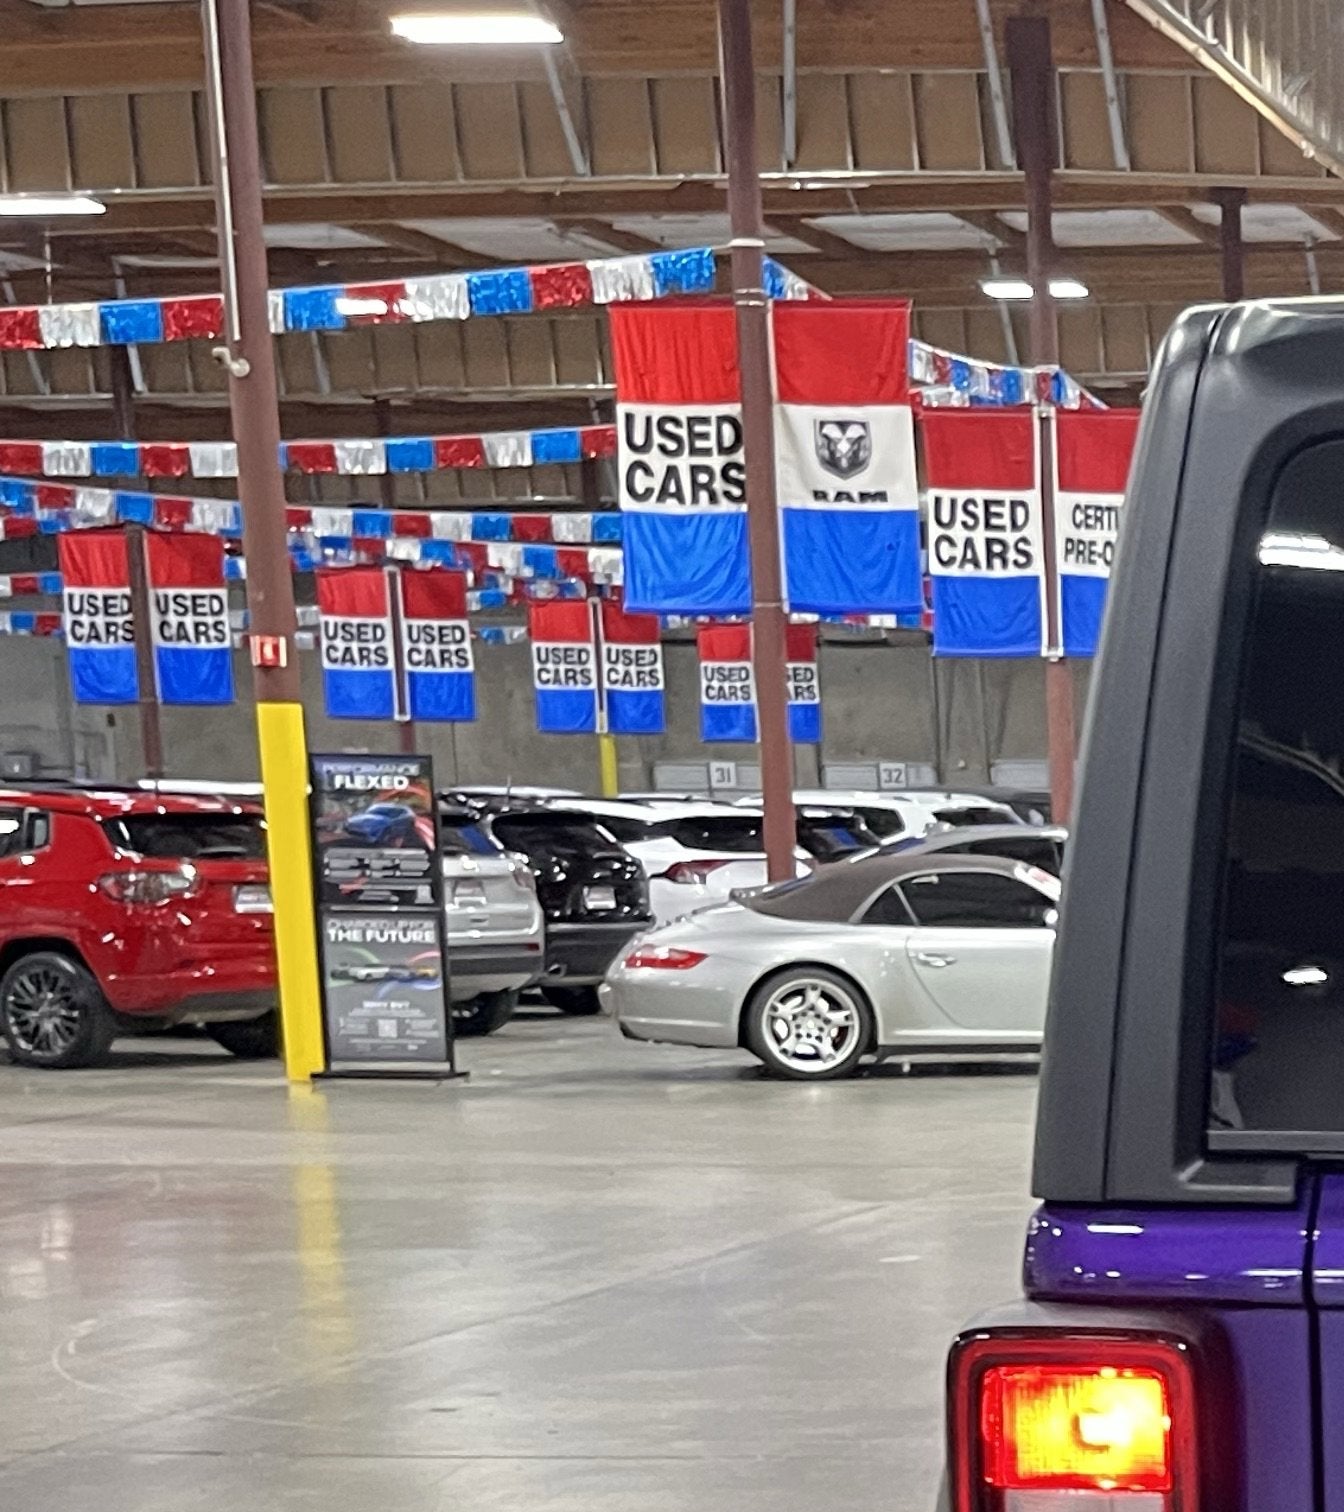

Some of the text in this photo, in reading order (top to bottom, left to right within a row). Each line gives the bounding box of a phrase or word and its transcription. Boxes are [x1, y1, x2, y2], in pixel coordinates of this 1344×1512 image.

[624, 412, 743, 458] USED
[625, 460, 746, 505] CARS
[934, 496, 1030, 532] USED
[934, 534, 1033, 570] CARS
[67, 593, 132, 616] USED
[155, 593, 224, 616] USED
[71, 620, 134, 643] CARS
[159, 620, 226, 643] CARS
[324, 621, 386, 643] USED
[407, 624, 466, 645] USED
[326, 645, 389, 667] CARS
[408, 647, 469, 668] CARS
[536, 647, 590, 667] USED
[606, 648, 658, 667] USED
[536, 668, 593, 686] CARS
[606, 668, 660, 687] CARS
[703, 666, 750, 682] USED
[704, 685, 751, 700] CARS
[334, 775, 409, 790] FLEXED
[714, 767, 732, 784] 31
[882, 769, 905, 784] 32
[328, 929, 436, 943] THE FUTURE
